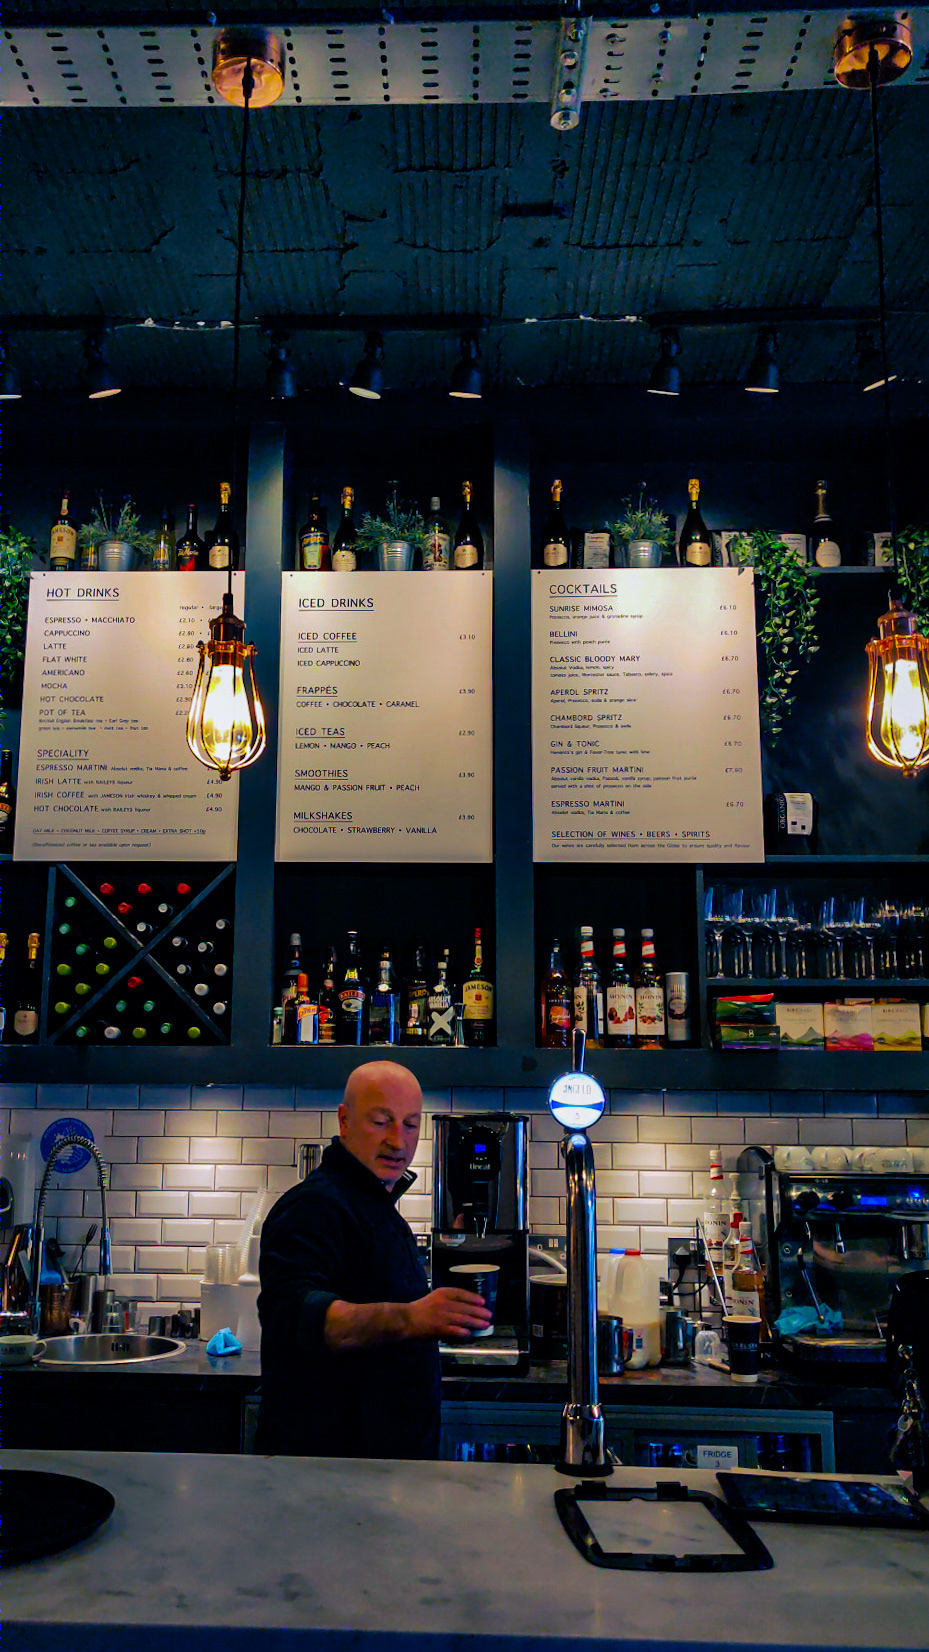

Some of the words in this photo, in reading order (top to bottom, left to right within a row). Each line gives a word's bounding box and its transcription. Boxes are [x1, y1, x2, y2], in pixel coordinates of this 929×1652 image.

[47, 588, 71, 597] HOT
[78, 588, 119, 597] DRINKS
[550, 584, 617, 595] COCKTAILS
[299, 599, 324, 608] ICED
[332, 598, 373, 607] DRINKS
[323, 633, 356, 641] COFFEE
[297, 685, 337, 694] FRAPPÉS
[296, 728, 316, 736] ICED
[322, 728, 344, 736] TEAS
[37, 749, 89, 758] SPECIALITY
[294, 812, 352, 820] MILKSHAKES
[552, 830, 594, 838] SELECTION
[596, 830, 607, 838] OF
[465, 984, 494, 993] JAMESON
[563, 1084, 591, 1095] ANGELO
[702, 1450, 732, 1458] FRIDGE
